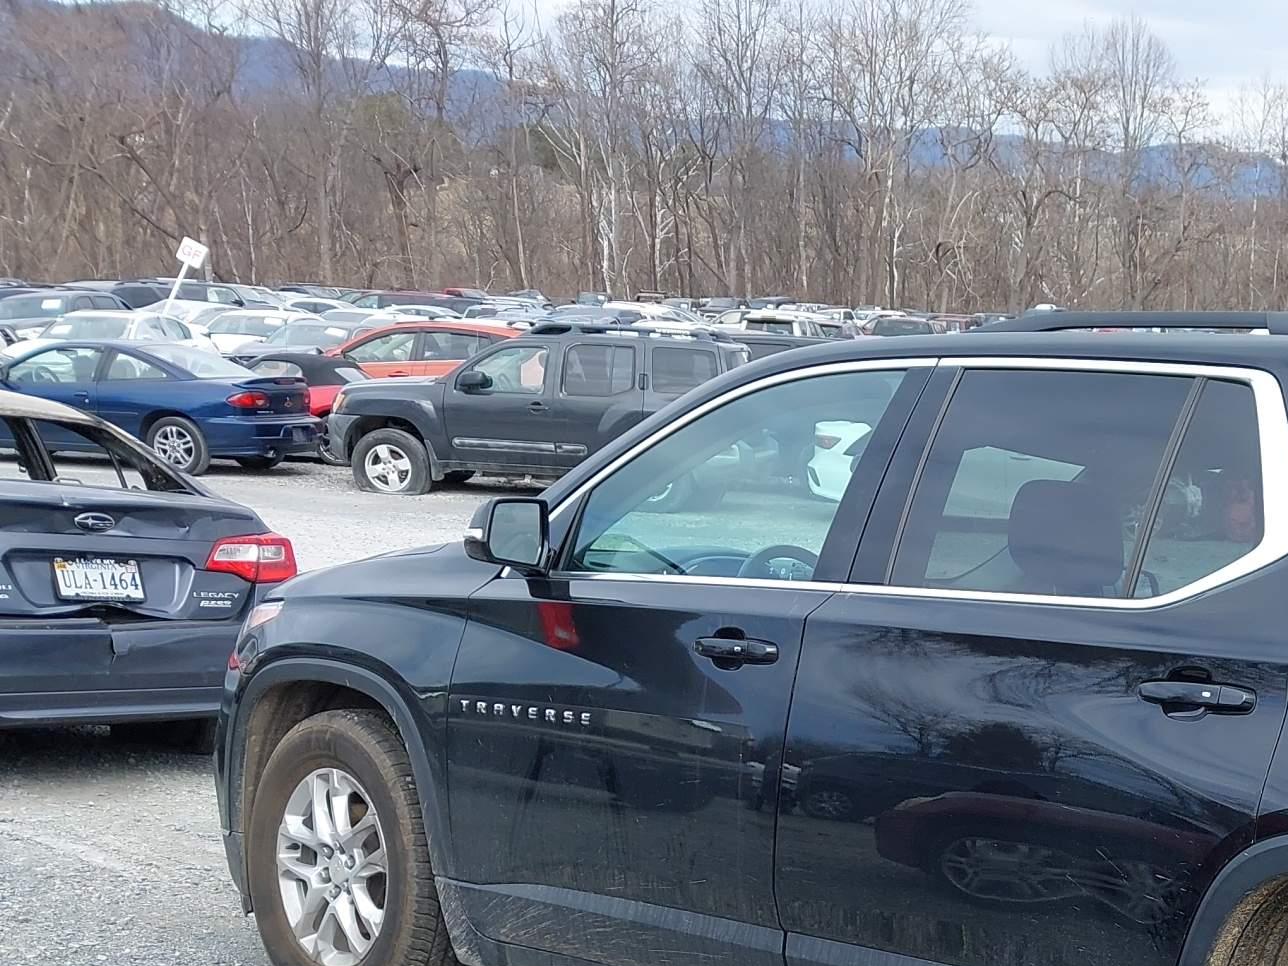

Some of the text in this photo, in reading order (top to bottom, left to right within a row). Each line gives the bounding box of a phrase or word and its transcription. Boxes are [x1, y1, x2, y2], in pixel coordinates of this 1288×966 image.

[61, 569, 140, 591] ULA-1464
[193, 591, 239, 599] LEGACY
[459, 699, 593, 726] TRAVERSE
